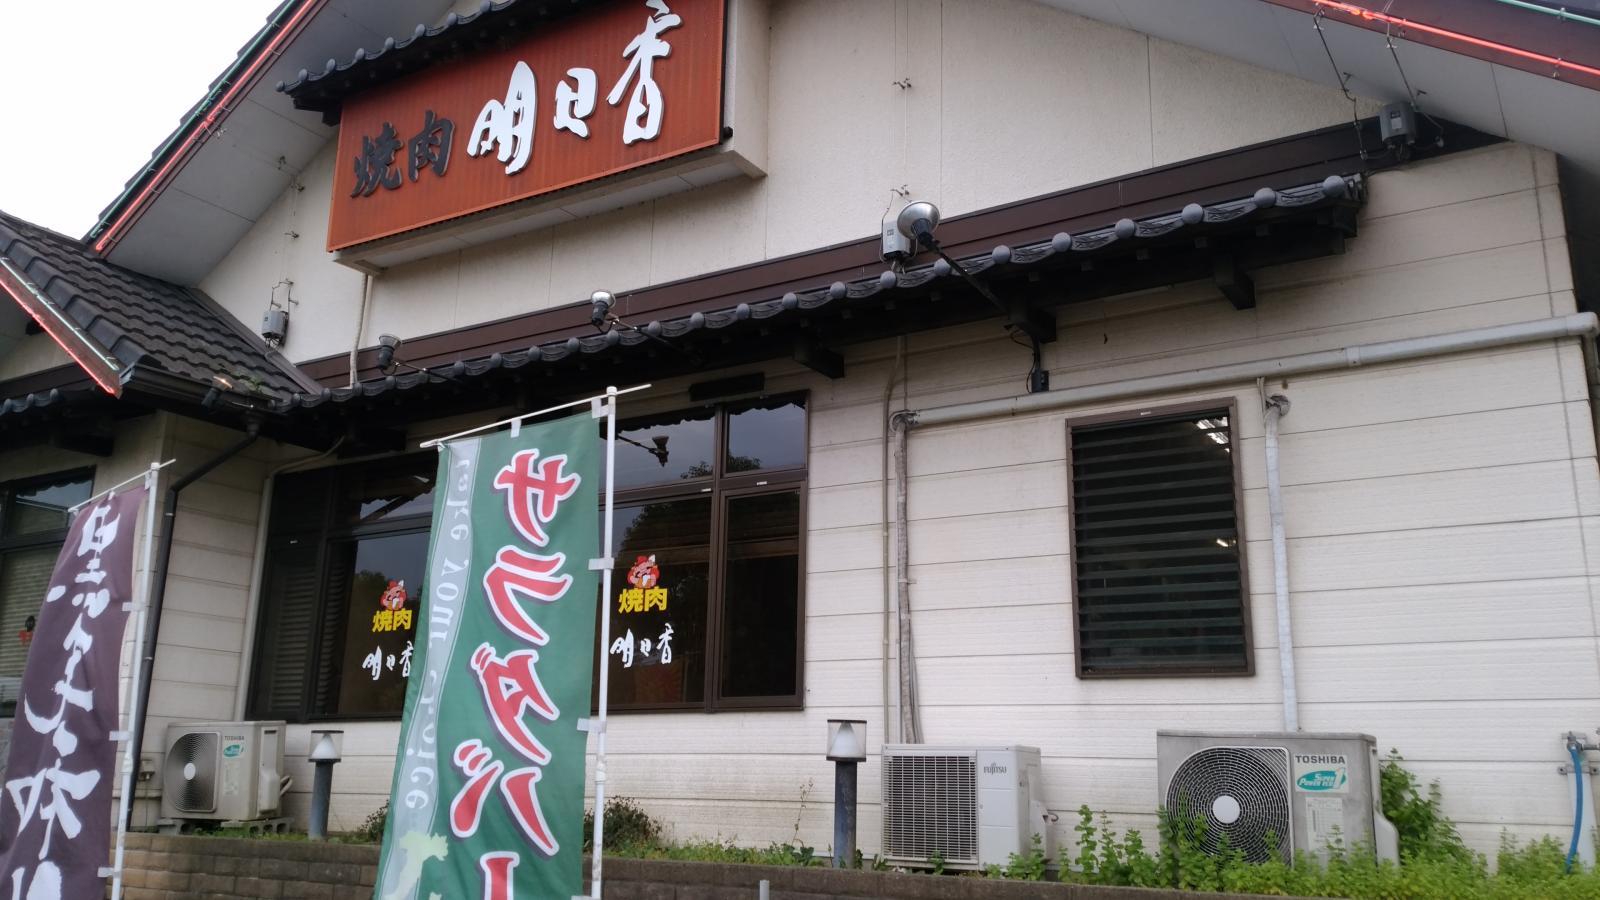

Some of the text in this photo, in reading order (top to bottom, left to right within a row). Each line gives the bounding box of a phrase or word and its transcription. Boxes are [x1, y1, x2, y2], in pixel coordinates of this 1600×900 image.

[350, 0, 682, 198] 焼肉 明日香
[619, 586, 668, 613] 焼肉
[372, 608, 412, 632] 焼肉
[610, 623, 674, 668] 明日香
[362, 641, 414, 681] 明日香
[983, 764, 1007, 775] FUJITSU
[1295, 755, 1345, 764] TOSHIBA
